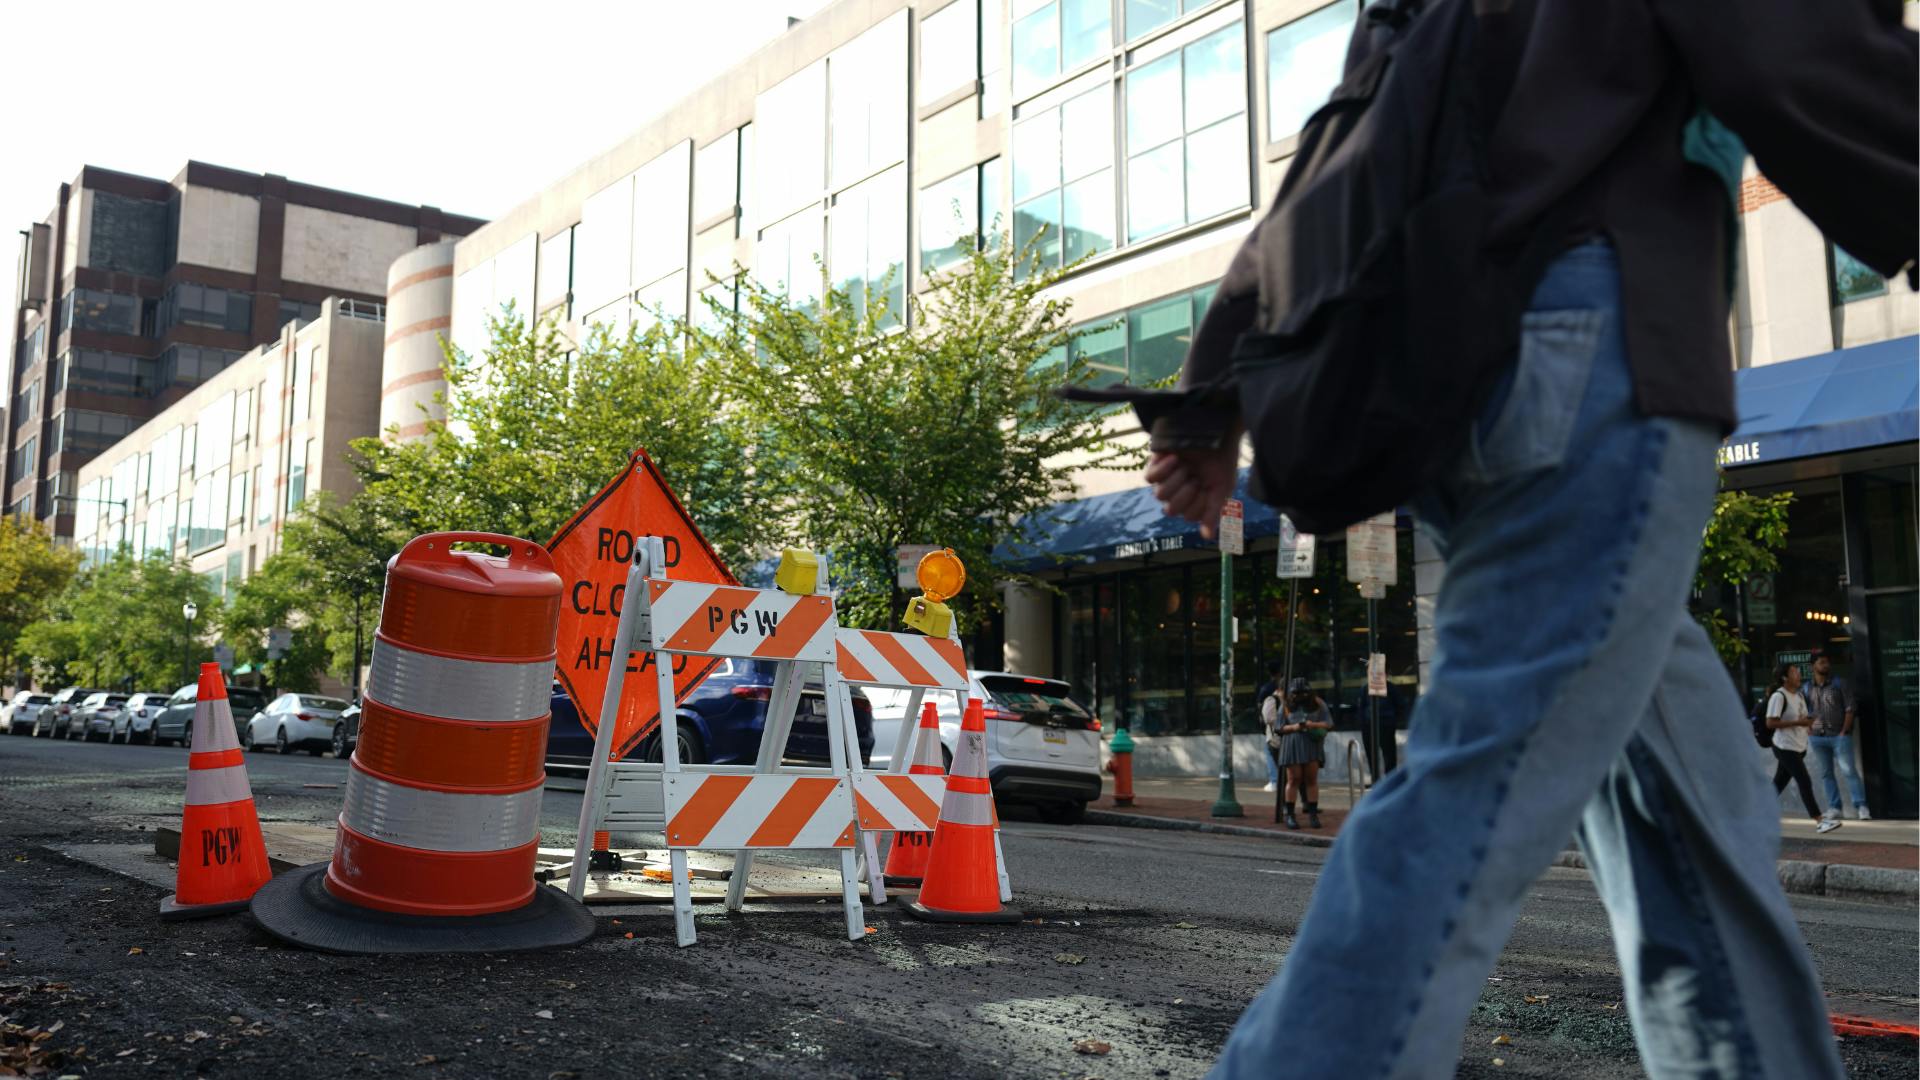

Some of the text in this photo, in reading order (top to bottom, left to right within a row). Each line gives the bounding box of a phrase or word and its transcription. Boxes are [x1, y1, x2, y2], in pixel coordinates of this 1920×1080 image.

[1717, 441, 1760, 464] TABLE
[597, 527, 681, 568] ROD
[1161, 535, 1184, 551] TABLE
[708, 606, 778, 637] PGW
[201, 827, 242, 867] PGW
